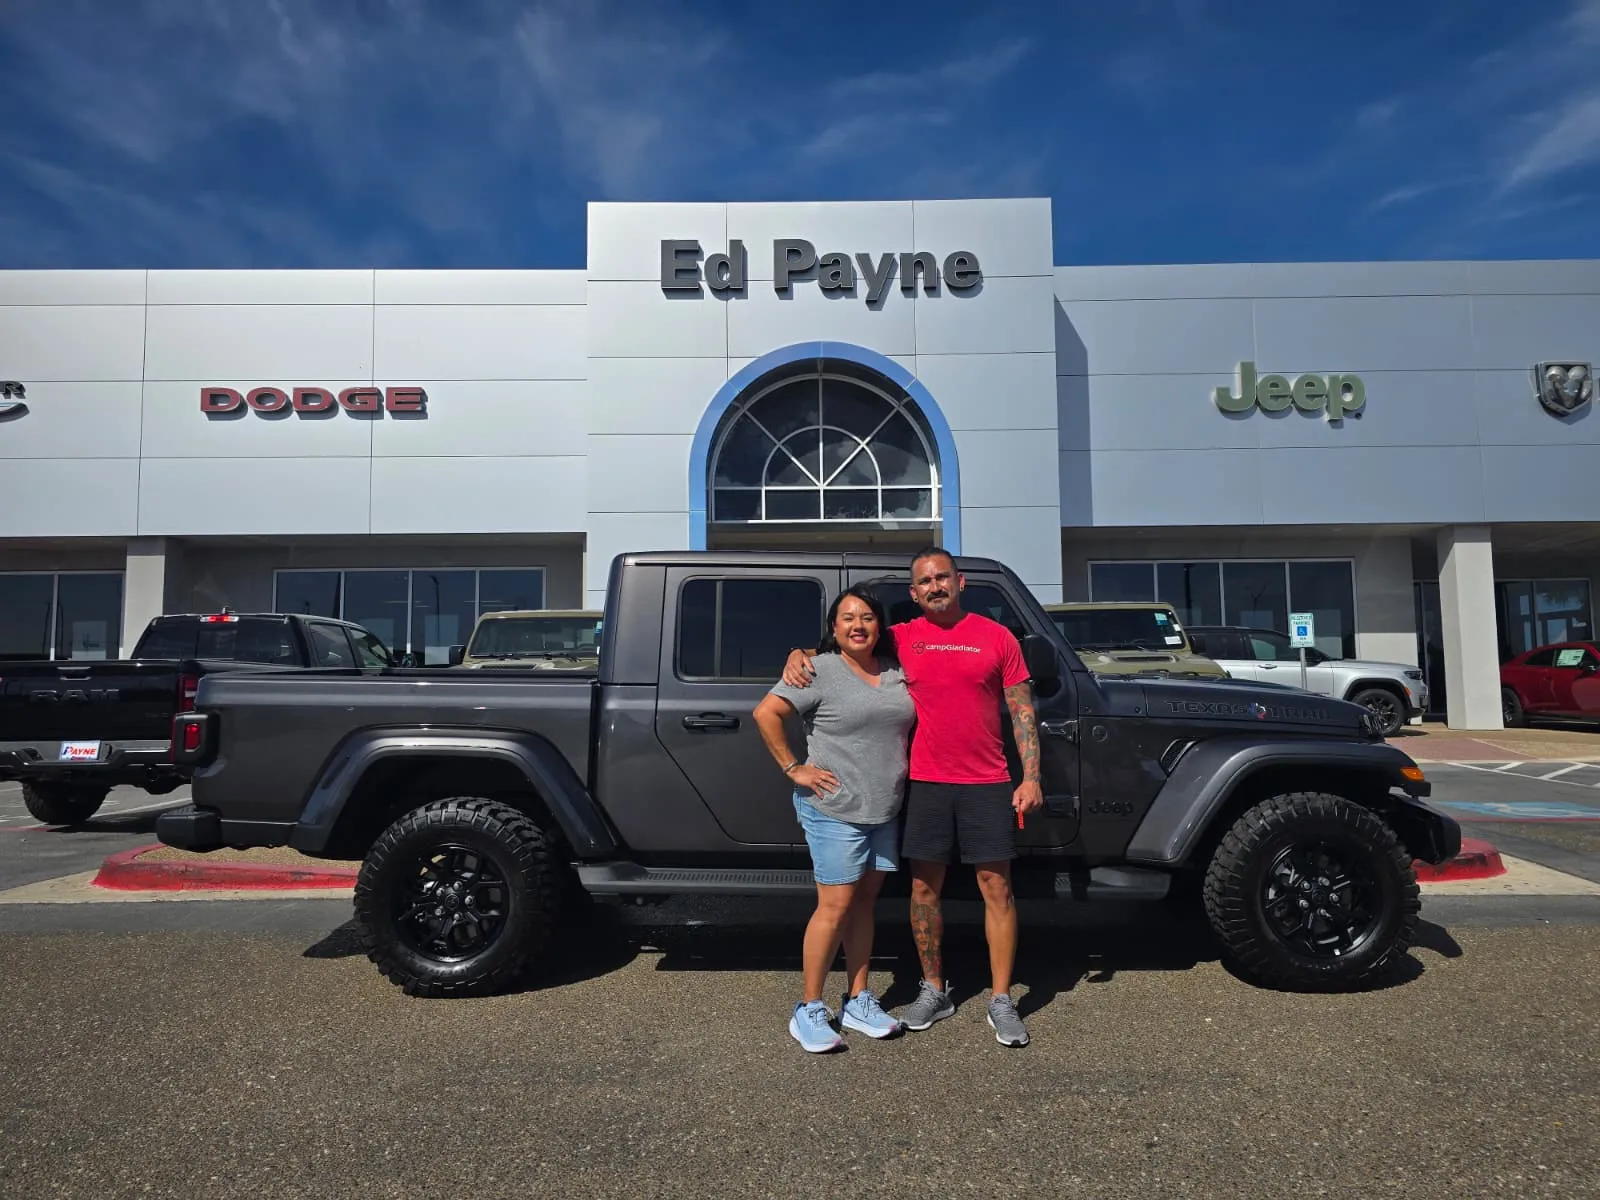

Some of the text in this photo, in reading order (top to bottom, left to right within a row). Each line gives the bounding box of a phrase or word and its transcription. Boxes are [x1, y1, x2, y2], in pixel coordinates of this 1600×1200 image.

[661, 238, 981, 305] Ed Payne
[200, 387, 423, 413] DODGE
[1215, 361, 1365, 420] Jeep
[63, 746, 97, 756] PAYNE
[1088, 799, 1134, 817] Jeep
